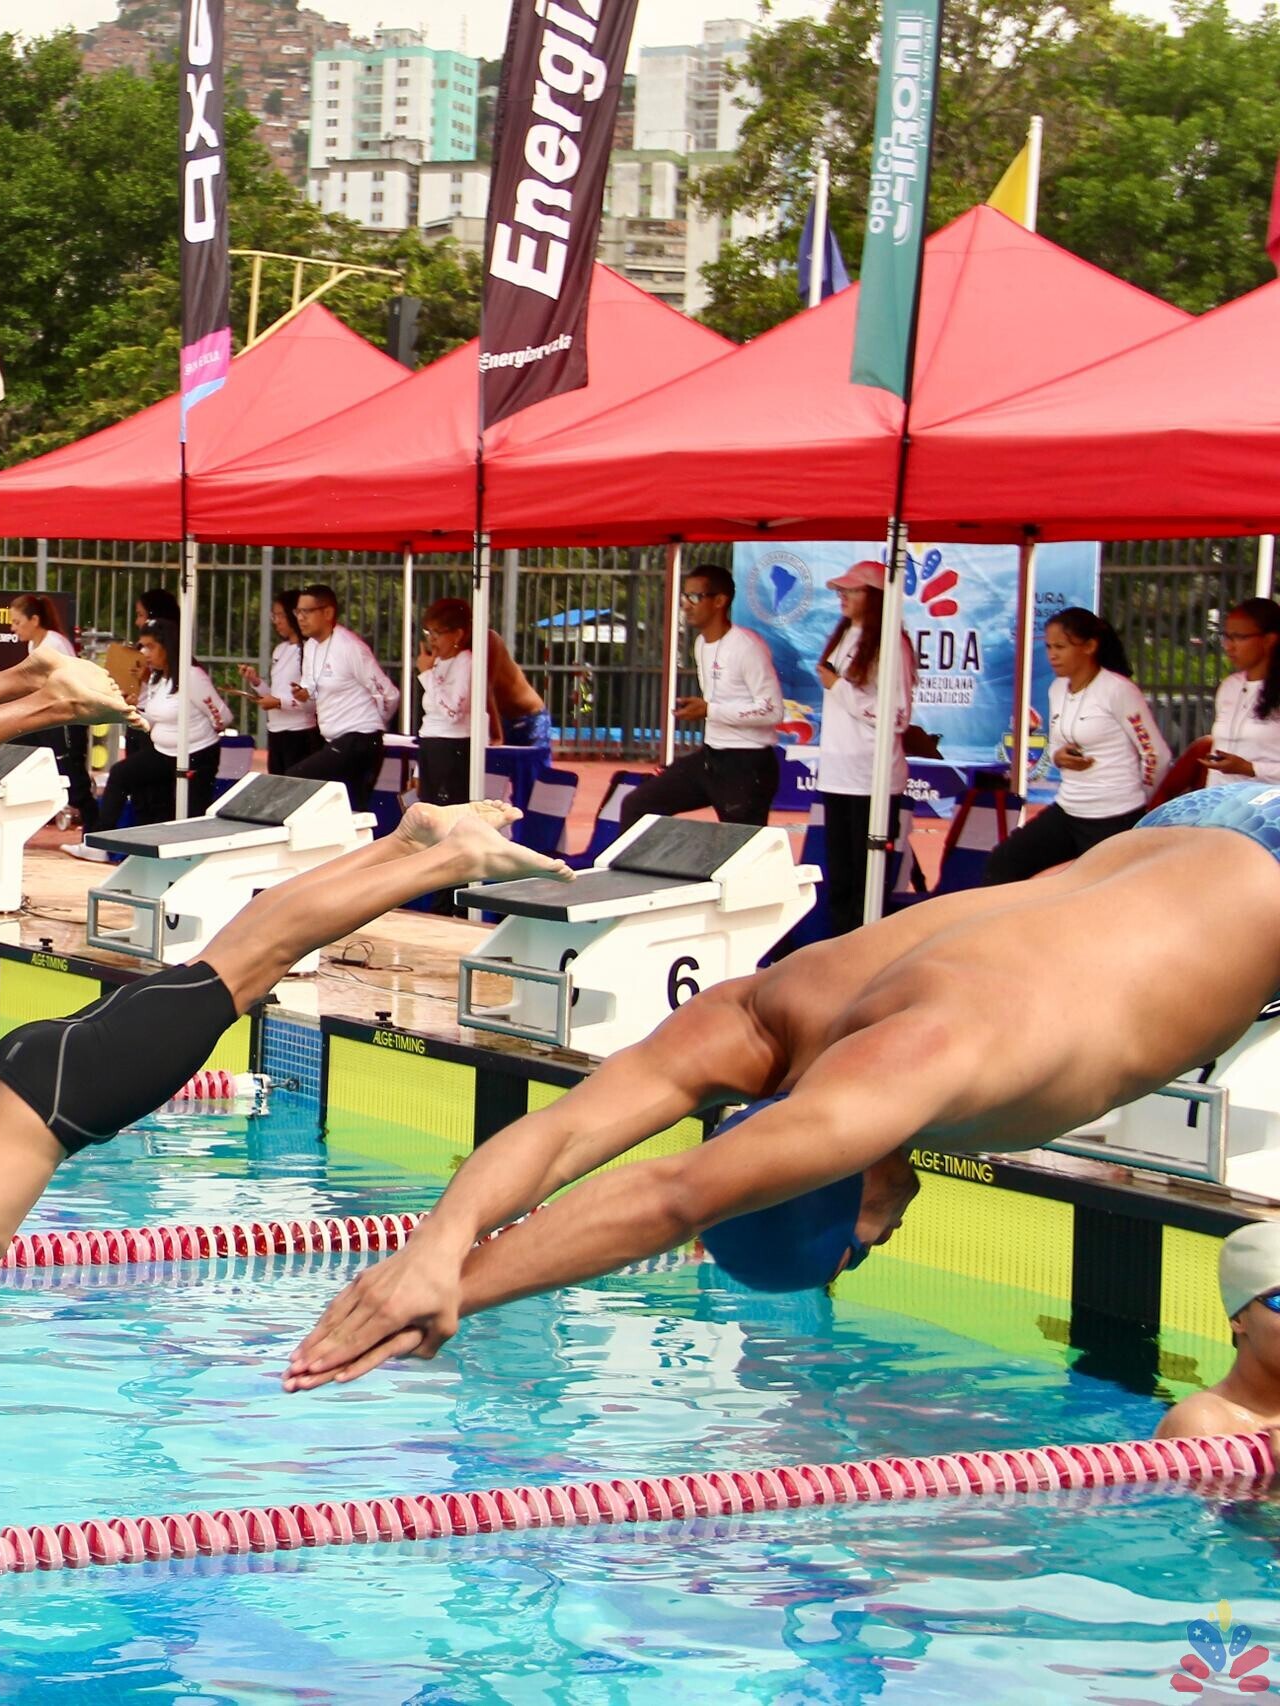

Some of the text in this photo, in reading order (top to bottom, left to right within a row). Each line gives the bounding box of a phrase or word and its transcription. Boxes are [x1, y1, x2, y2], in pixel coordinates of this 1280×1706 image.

[917, 630, 980, 671] EDA
[919, 677, 974, 690] ENEZOLANA
[667, 956, 701, 1012] 6
[373, 1030, 426, 1053] ALGE-TIMING
[908, 1148, 995, 1183] ALGE-TIMING
